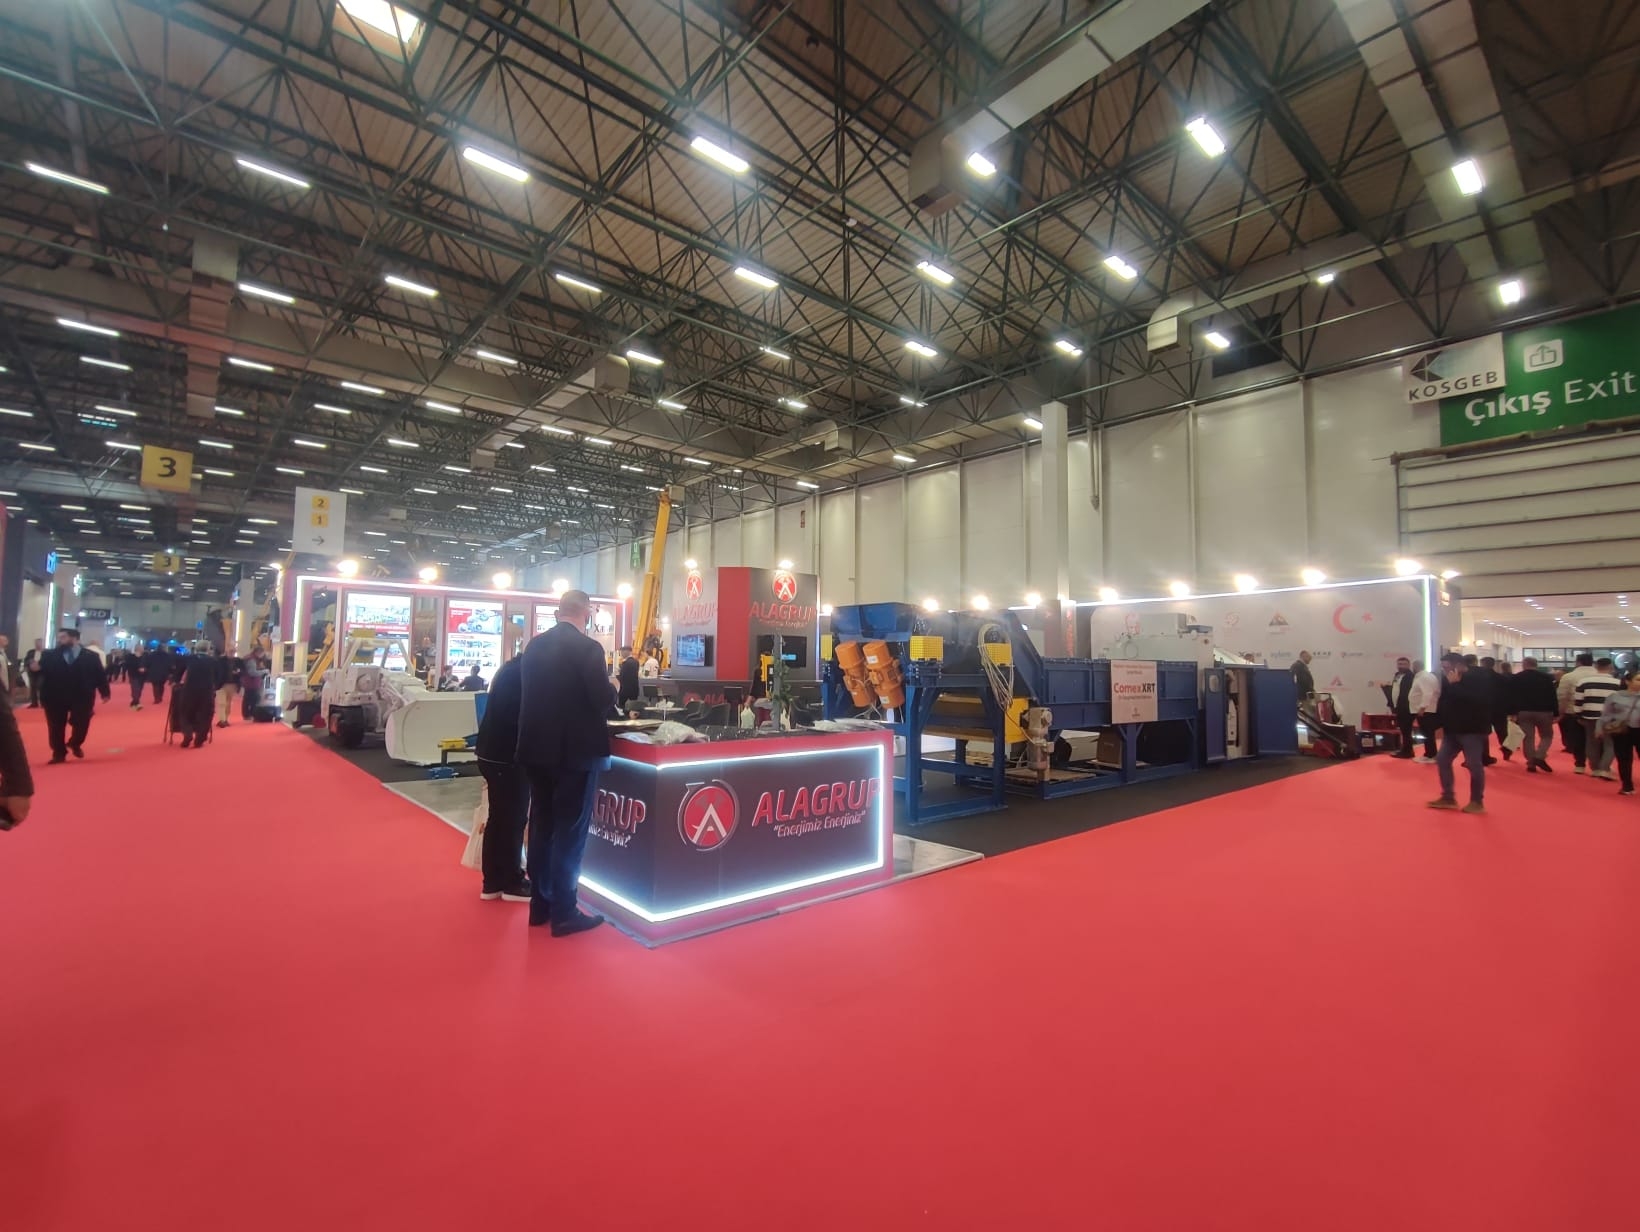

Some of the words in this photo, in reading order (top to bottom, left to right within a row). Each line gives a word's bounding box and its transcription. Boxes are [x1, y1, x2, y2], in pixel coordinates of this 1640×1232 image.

[1409, 371, 1498, 401] KOSGEB
[1465, 390, 1552, 426] Çıkış
[1565, 371, 1637, 404] Exit
[157, 457, 177, 478] 3
[317, 498, 325, 508] 2
[162, 555, 172, 567] 3
[748, 601, 817, 622] ALAGRUP
[592, 788, 646, 834] GRUP
[751, 777, 881, 828] ALAGRUP
[773, 818, 823, 838] "Enerjimiz
